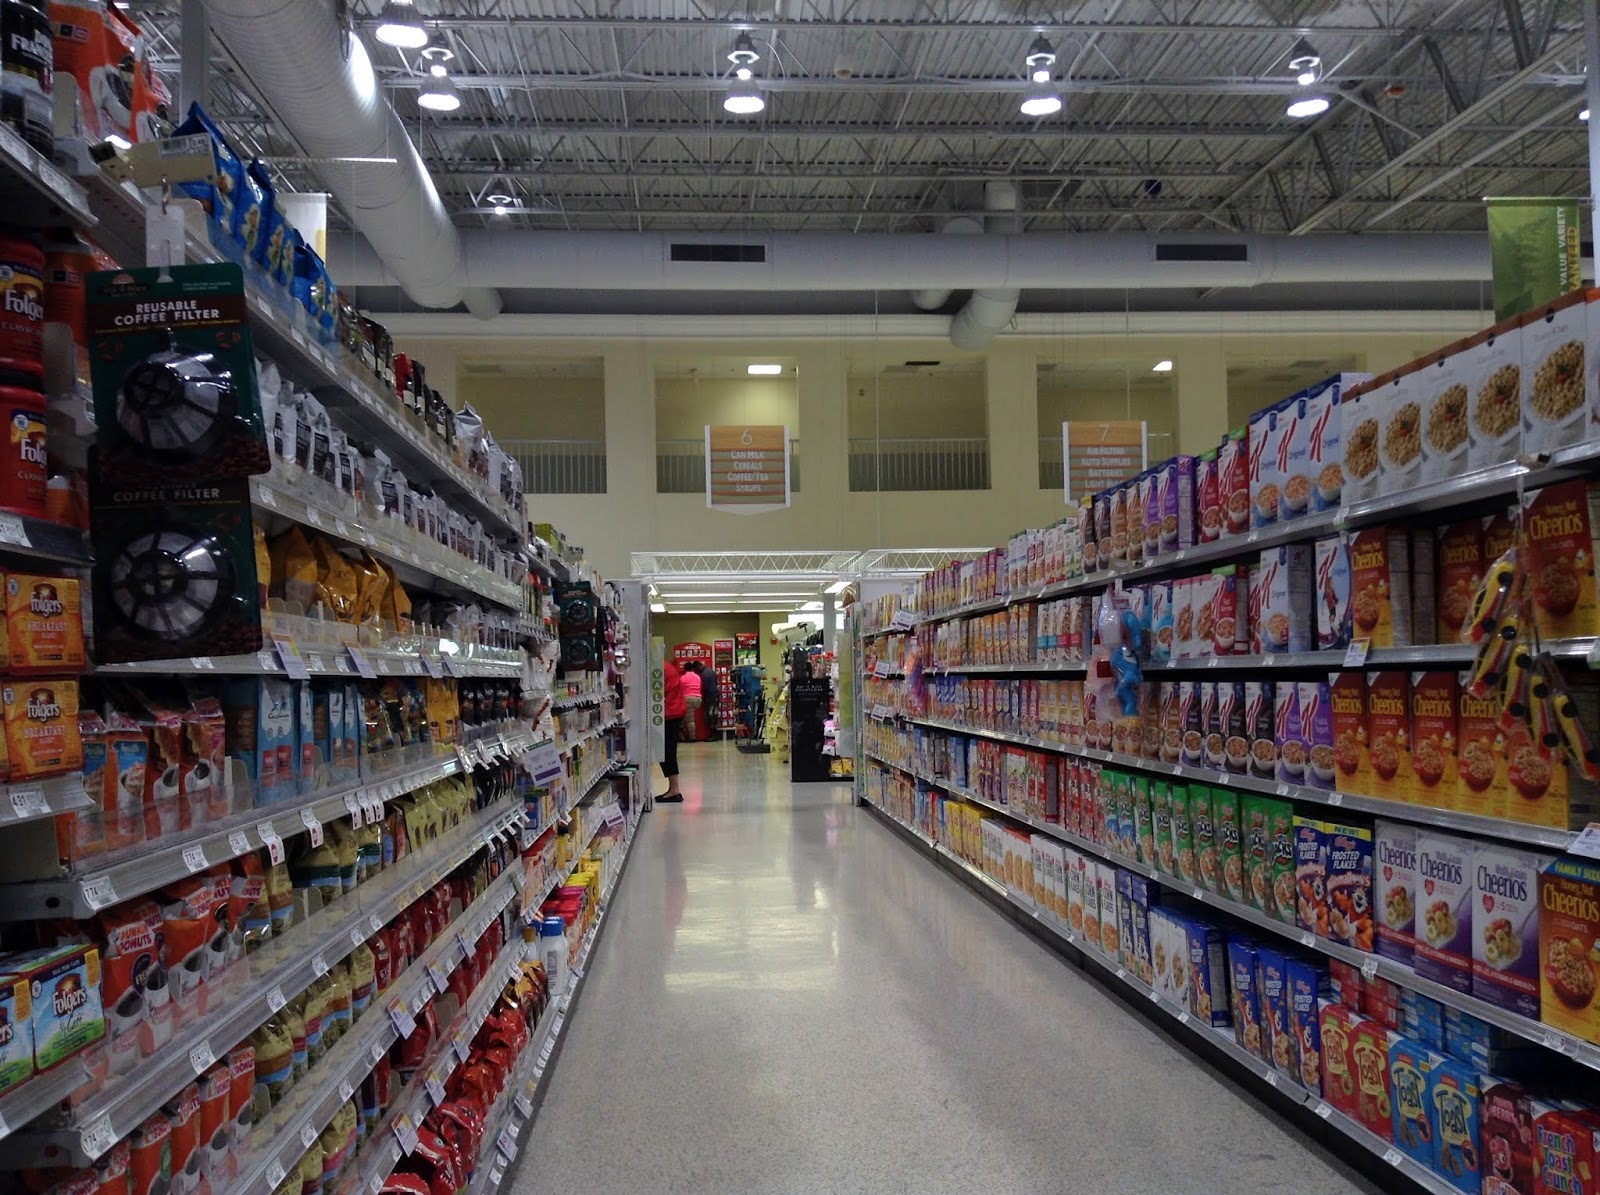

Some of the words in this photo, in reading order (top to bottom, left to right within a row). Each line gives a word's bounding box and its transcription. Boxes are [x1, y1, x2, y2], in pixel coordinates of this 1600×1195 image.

[1557, 206, 1566, 248] VARIETY
[1559, 252, 1568, 286] VALUE
[114, 311, 167, 326] COFFEE
[174, 308, 220, 321] FILTER
[136, 300, 197, 314] REUSABLE
[741, 427, 753, 446] 6
[1099, 424, 1110, 442] 7
[733, 462, 763, 470] CEREALS
[747, 451, 765, 459] MILK
[113, 490, 166, 502] COFFEE
[174, 487, 220, 499] FILTER
[1529, 512, 1583, 540] Cheerios
[31, 591, 62, 617] Folgers
[27, 698, 60, 722] Folgers
[1413, 694, 1451, 717] Cheerios
[1332, 851, 1360, 860] FROSTED
[1332, 860, 1357, 870] FLAKES
[1420, 851, 1463, 885] Cheerios
[1477, 865, 1528, 902] Cheerios
[1543, 882, 1600, 922] Cheerios
[52, 986, 87, 1016] Folgers
[1537, 1124, 1576, 1155] French
[1543, 1146, 1573, 1176] Toast
[1541, 1165, 1583, 1195] Crunch
